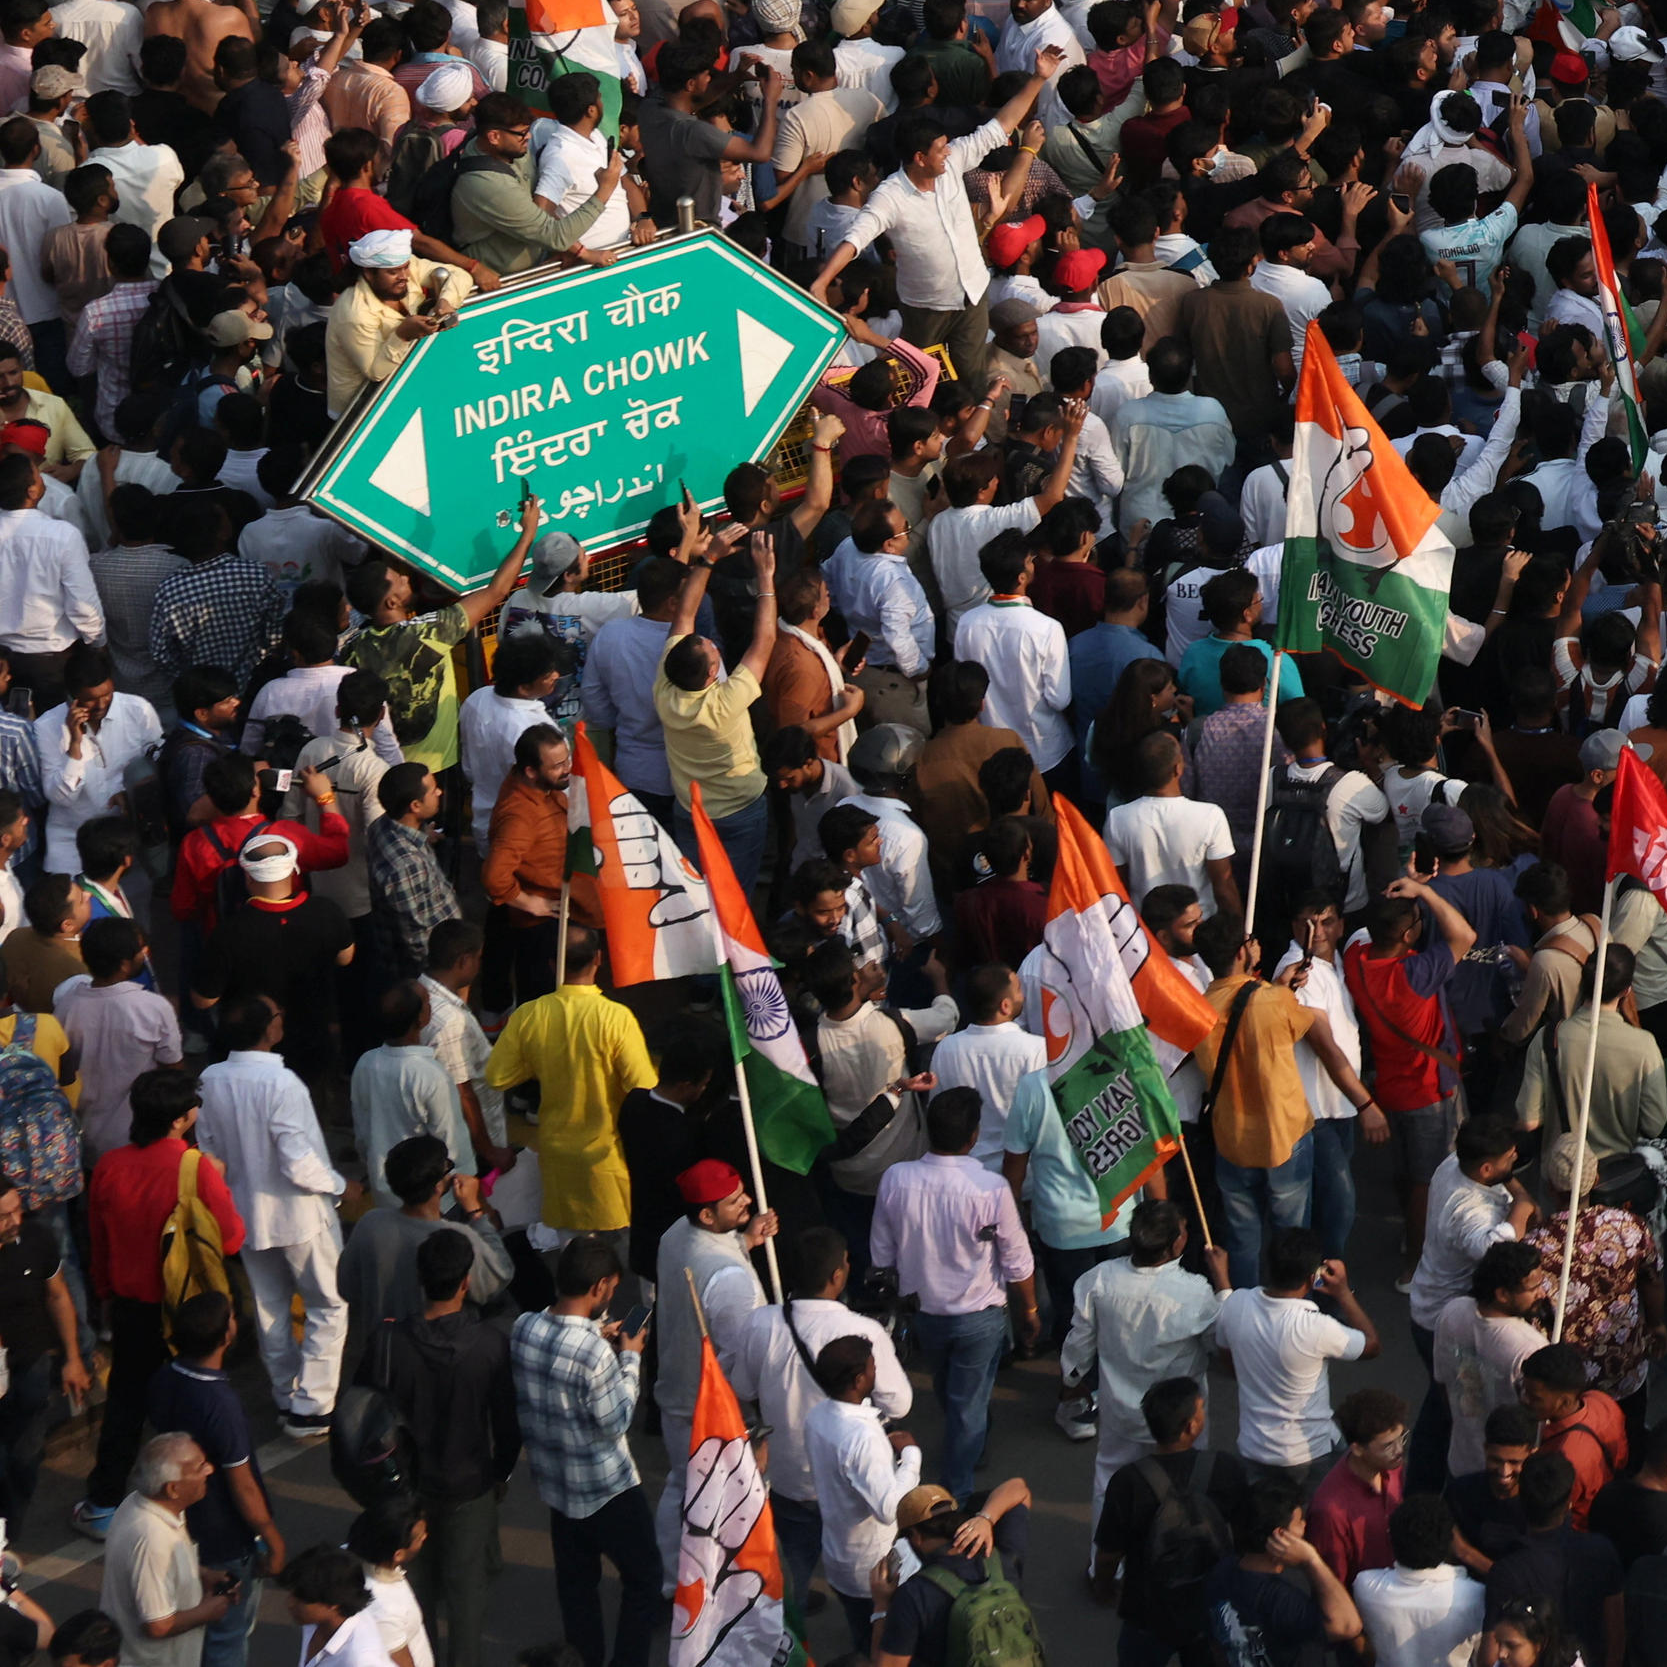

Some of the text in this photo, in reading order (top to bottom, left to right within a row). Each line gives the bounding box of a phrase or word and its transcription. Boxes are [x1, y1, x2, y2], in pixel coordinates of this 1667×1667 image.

[473, 282, 683, 375] इन्दिरा चौक
[453, 331, 711, 438] INDIRA CHOWK
[1340, 593, 1409, 639] YOUTH
